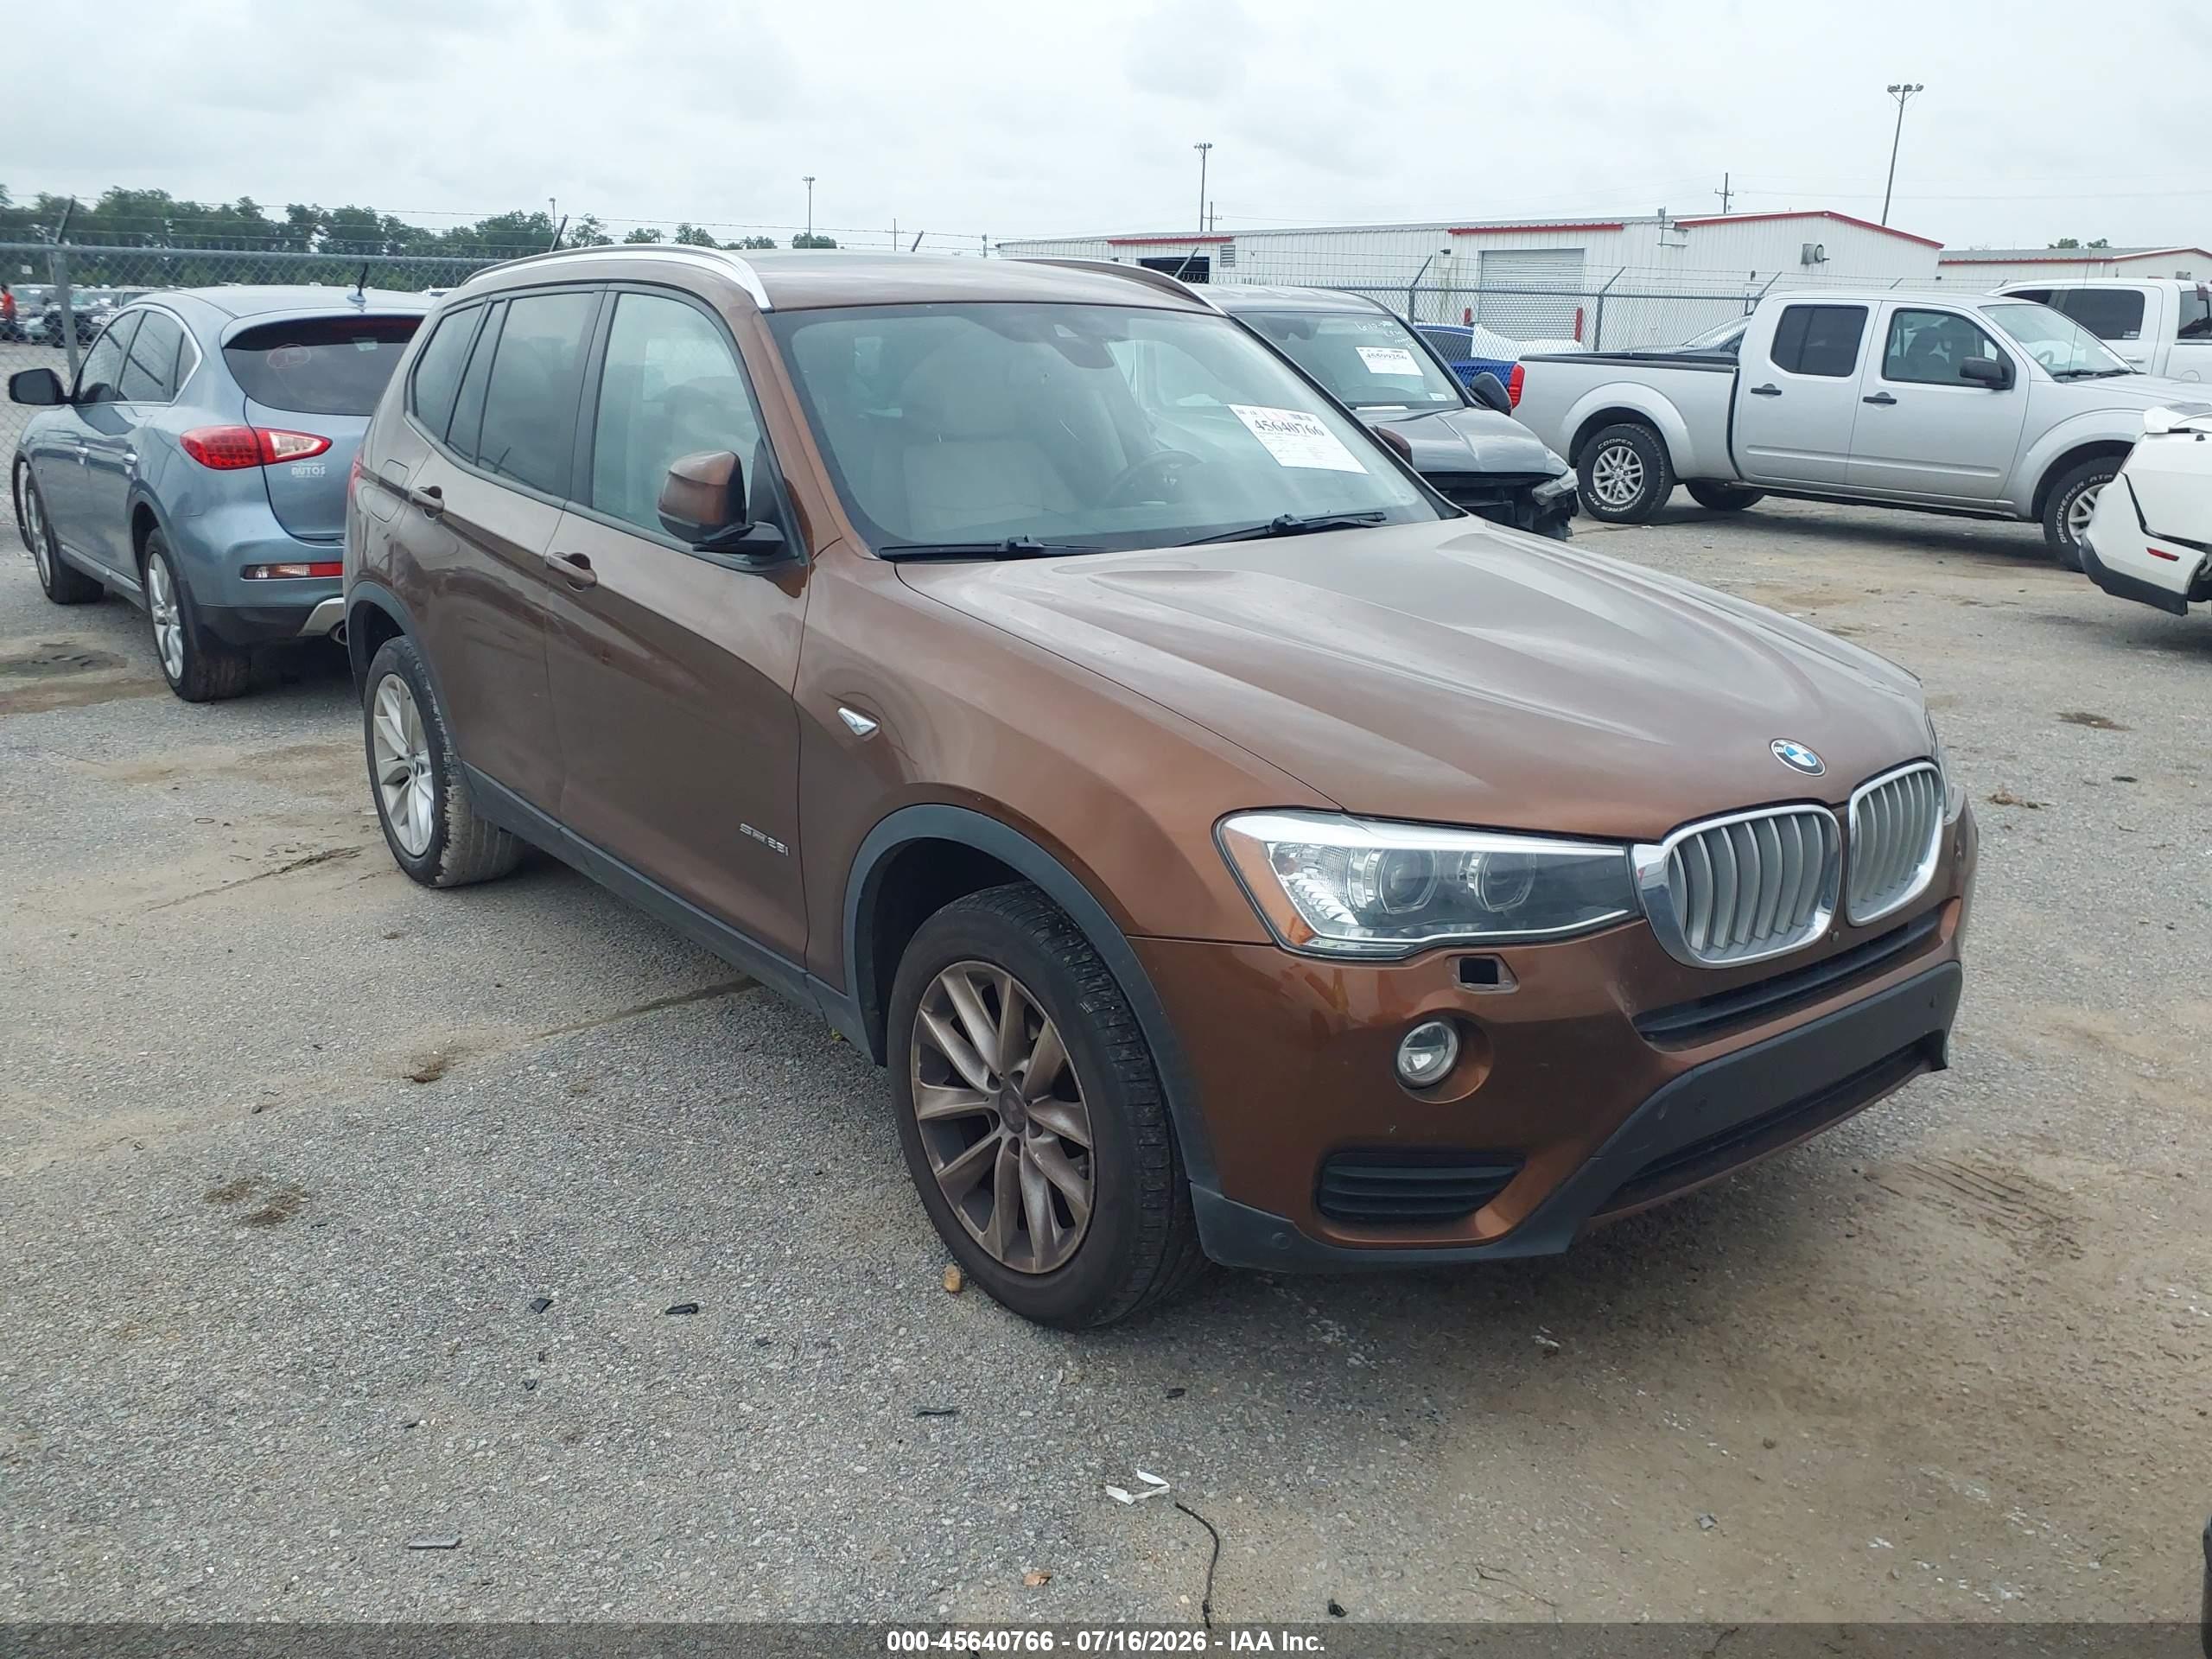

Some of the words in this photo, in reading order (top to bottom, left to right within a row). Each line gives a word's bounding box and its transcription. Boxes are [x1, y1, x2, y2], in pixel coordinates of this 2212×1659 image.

[1255, 420, 1325, 436] 45640766
[1598, 438, 1634, 450] COOPER
[2056, 480, 2085, 544] DISCOVERER
